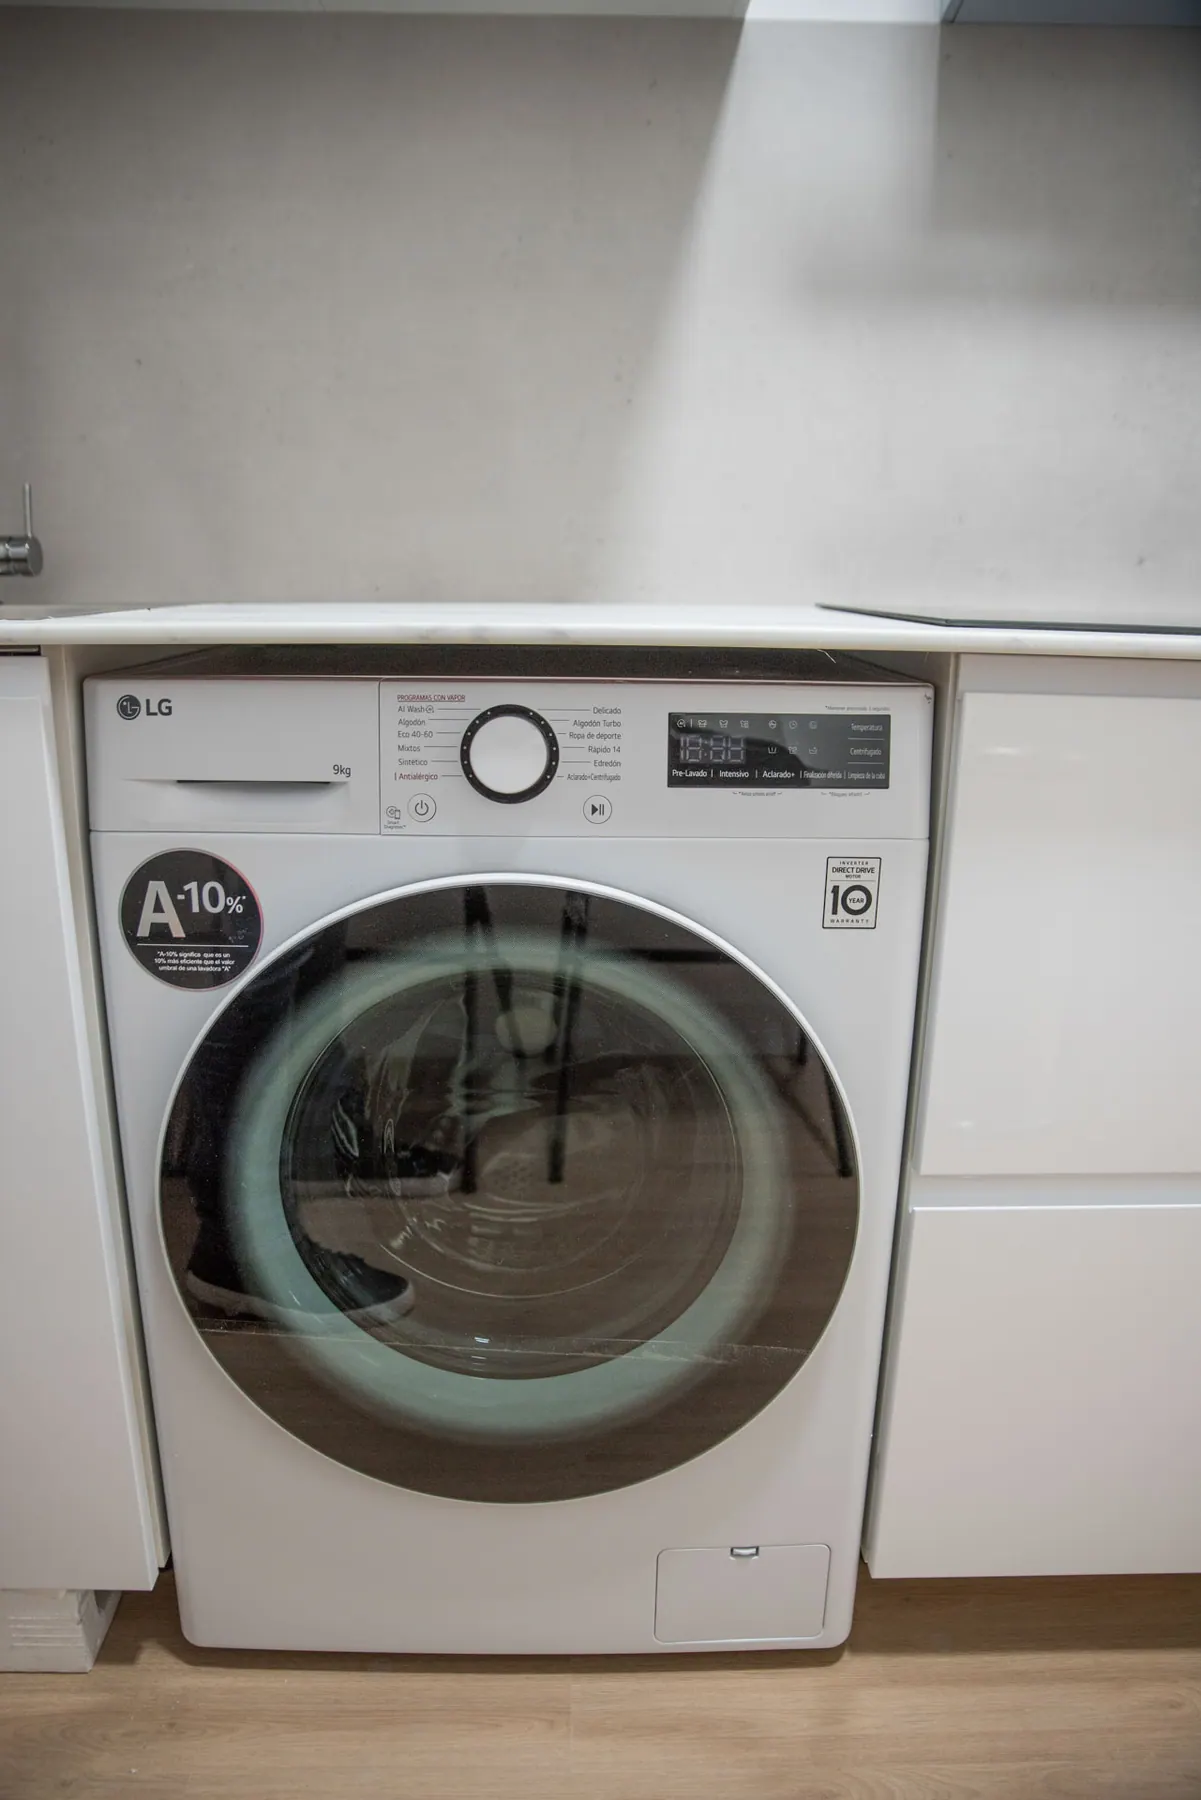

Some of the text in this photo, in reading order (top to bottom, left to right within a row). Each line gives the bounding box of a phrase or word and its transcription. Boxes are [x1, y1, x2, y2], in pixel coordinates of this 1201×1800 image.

[145, 698, 173, 716] LG
[407, 705, 425, 713] Wash
[592, 706, 622, 715] Delicado
[398, 718, 426, 727] Algodón
[573, 719, 601, 729] Algodón
[851, 722, 883, 732] Temperatura
[397, 730, 434, 738] Eco 40-60
[569, 731, 622, 740] Ropa de deporte
[397, 744, 421, 752] Mixtos
[588, 745, 611, 754] Rápido
[849, 747, 882, 757] Centrifugado
[398, 758, 428, 766] Sintético
[593, 759, 621, 767] Edredón
[332, 764, 352, 777] 9kg
[672, 769, 708, 777] Pre-Lavado
[719, 769, 749, 778] Intensivo
[762, 770, 795, 778] Aclarado+
[398, 772, 438, 782] Antialérgico
[831, 884, 872, 916] 10
